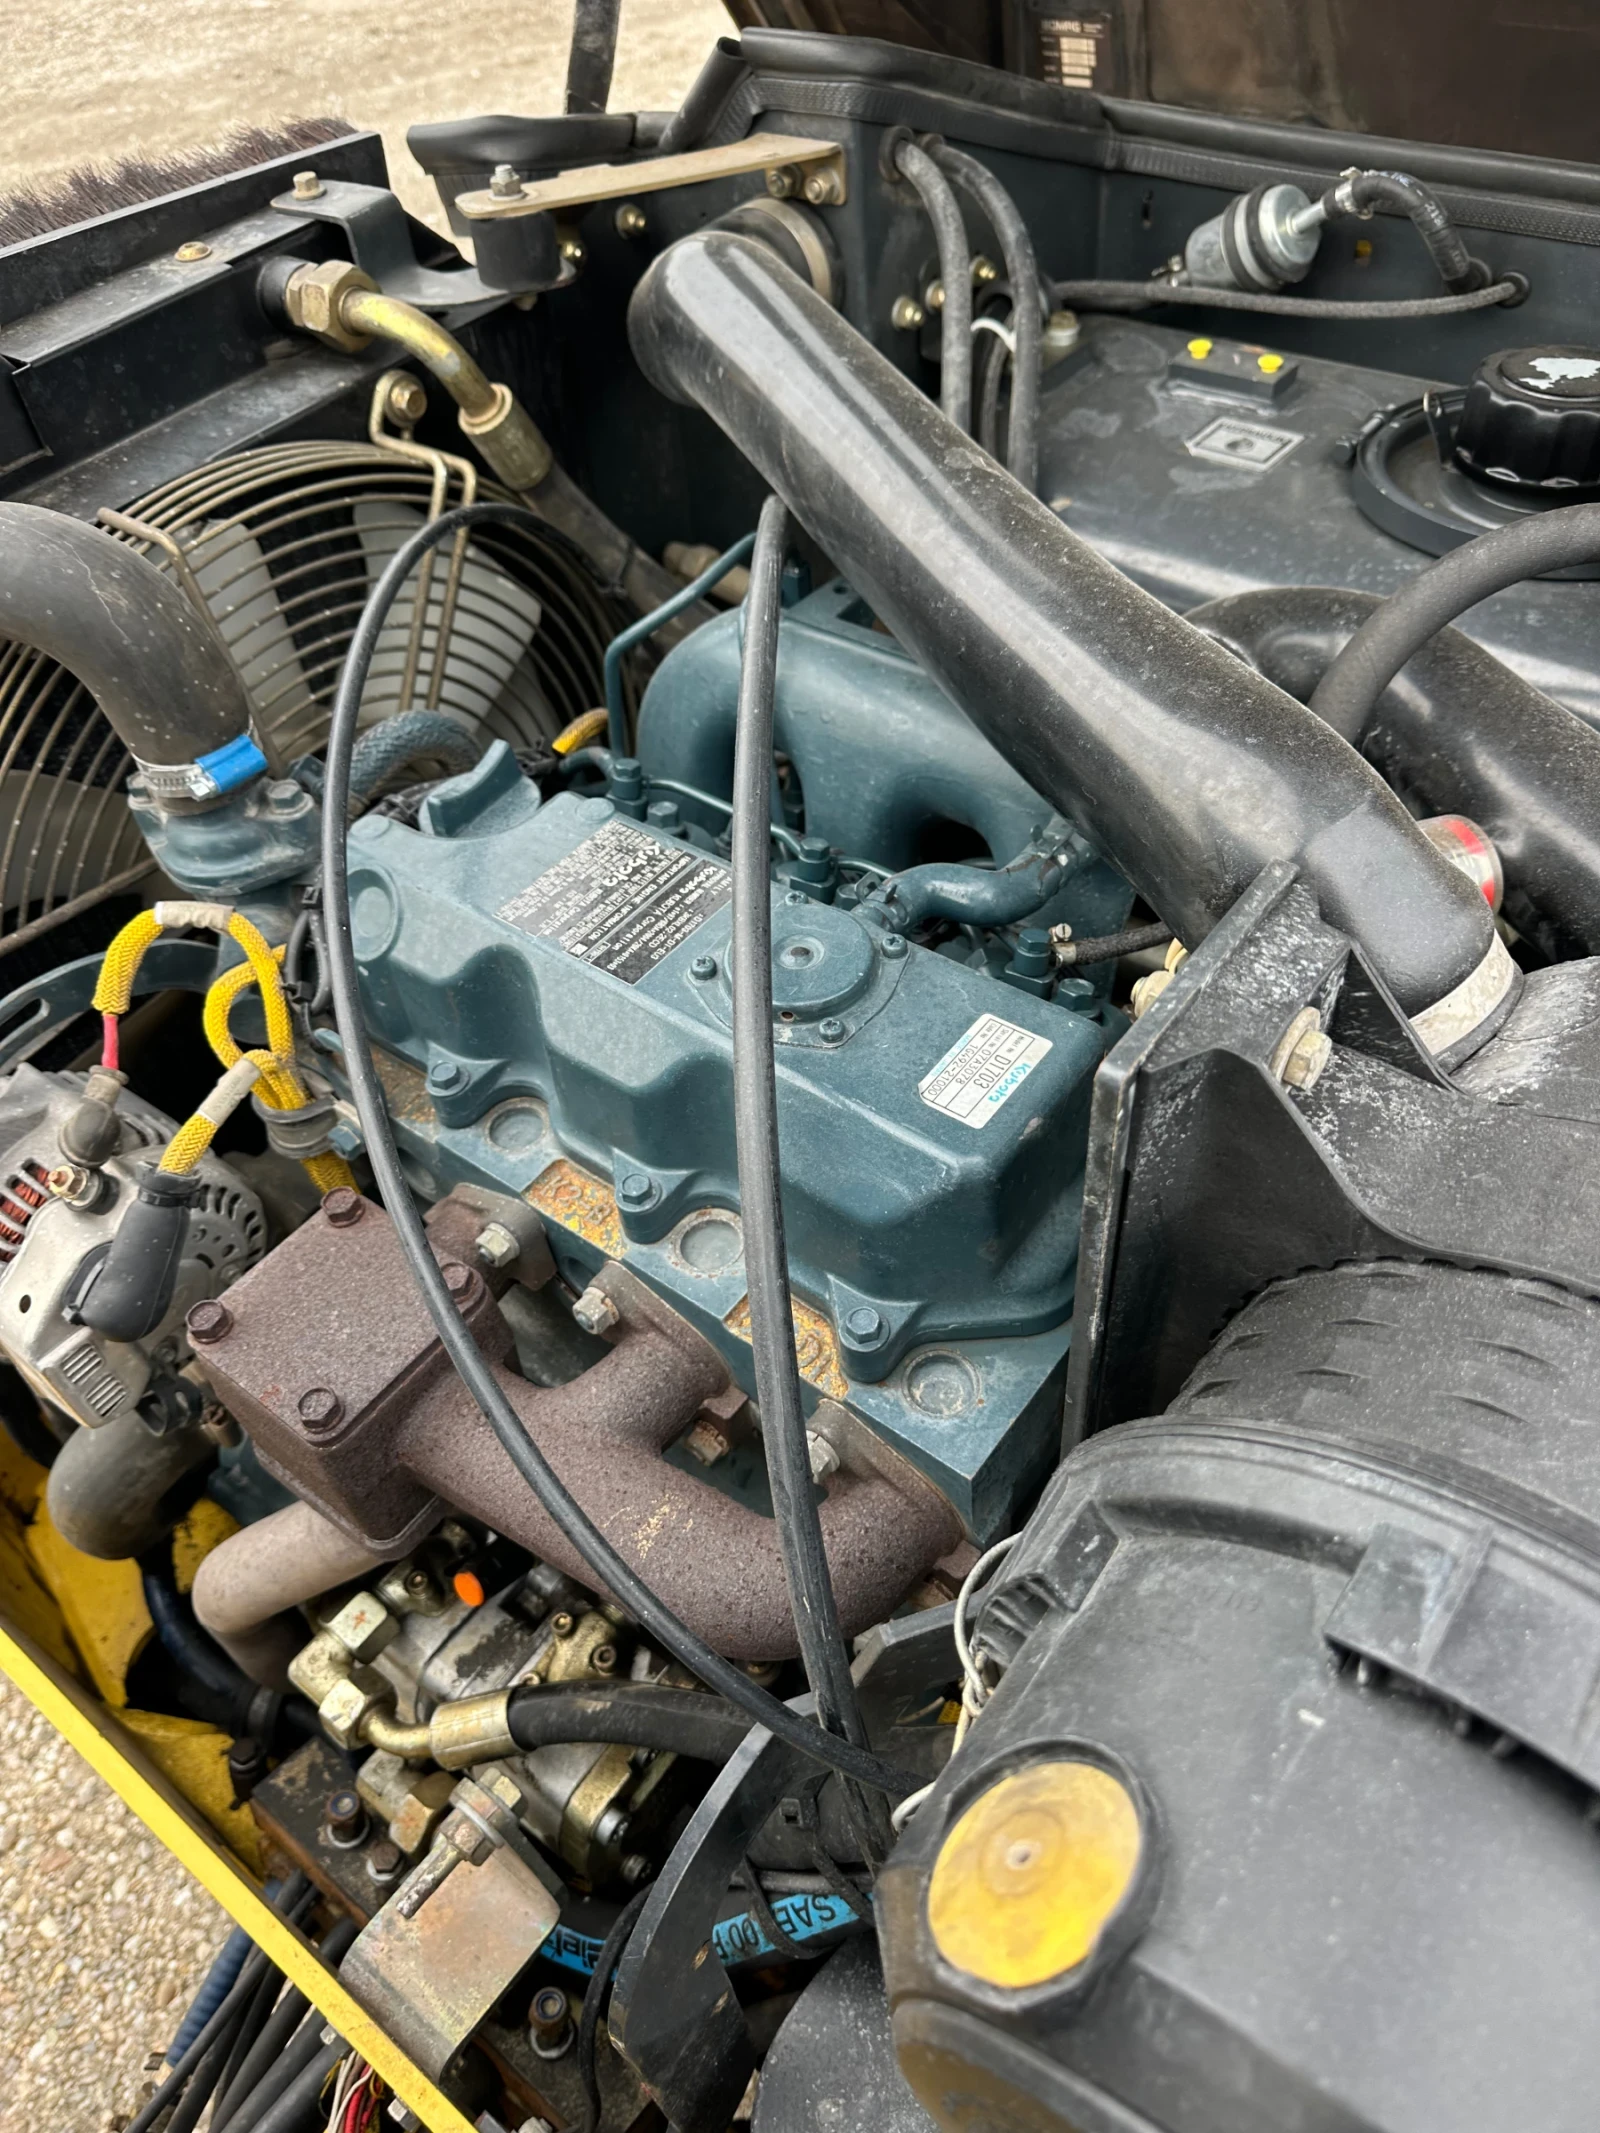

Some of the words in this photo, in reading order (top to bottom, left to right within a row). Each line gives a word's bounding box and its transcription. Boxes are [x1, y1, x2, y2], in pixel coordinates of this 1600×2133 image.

[602, 841, 665, 888] Kubota
[656, 856, 689, 883] IMPORTANT
[631, 884, 657, 903] ENGINE
[653, 893, 681, 915] KUBOTA
[588, 906, 631, 938] INFORMATION
[611, 915, 653, 949] Corporation
[928, 1044, 977, 1095] 1G492-21000
[956, 1049, 990, 1084] 07A3078
[973, 1055, 1010, 1088] D1703
[988, 1062, 1030, 1103] Kubota
[774, 1894, 836, 1935] SAE
